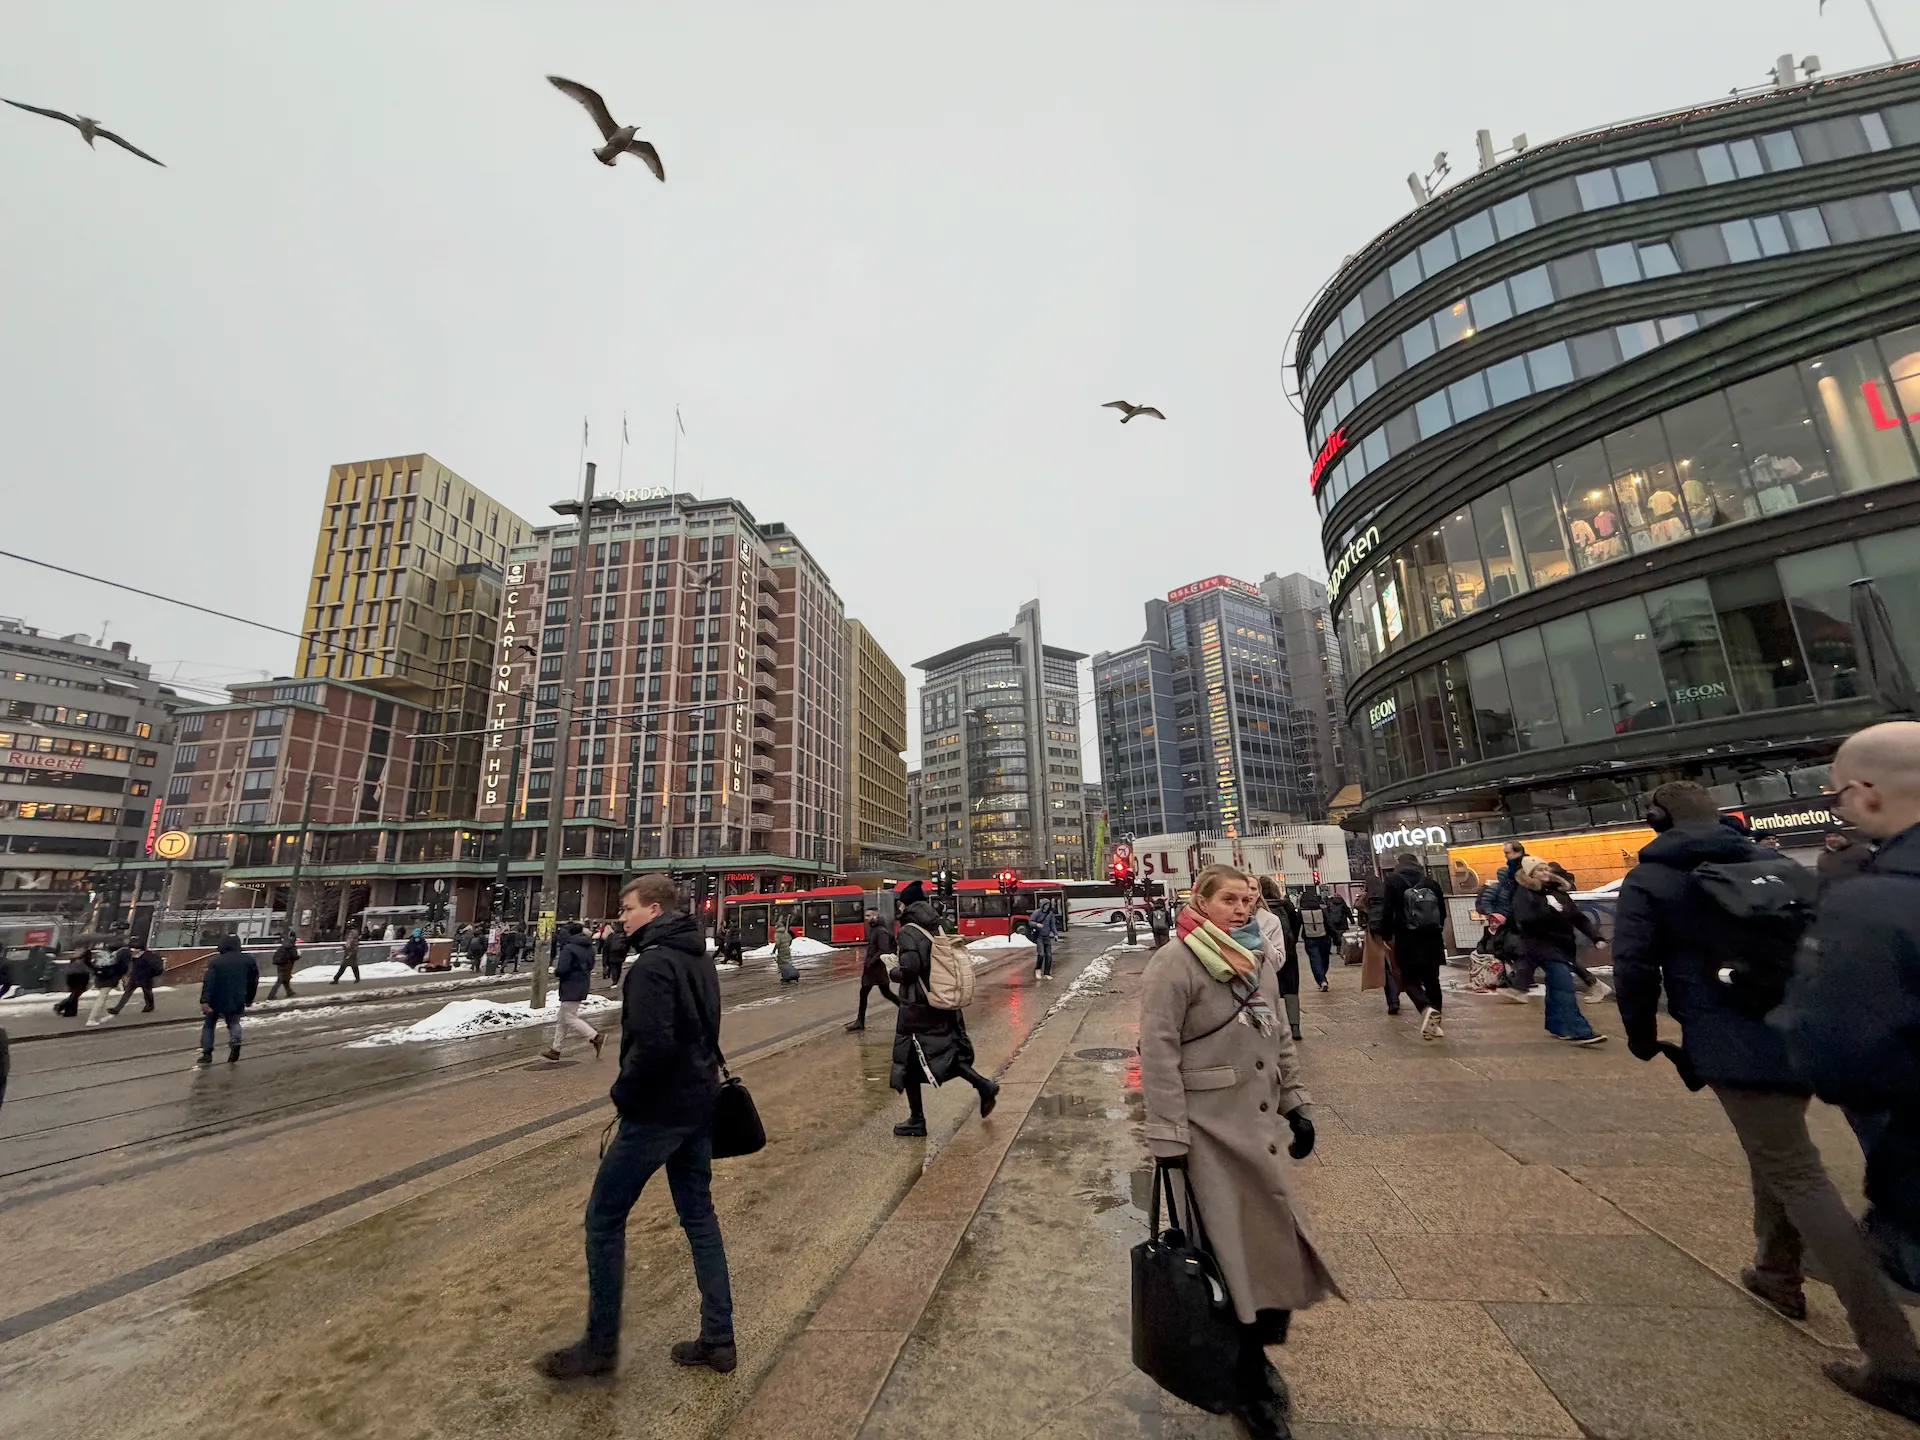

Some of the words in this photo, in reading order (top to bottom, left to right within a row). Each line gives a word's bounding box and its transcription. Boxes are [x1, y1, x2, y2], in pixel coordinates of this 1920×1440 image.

[498, 591, 519, 693] CLARION
[738, 570, 748, 676] CLARION
[736, 685, 744, 732] THE
[1369, 696, 1397, 725] EGON
[1675, 682, 1727, 701] EGON
[492, 703, 507, 748] THE
[485, 758, 501, 804] HUB
[733, 743, 742, 792] HUB
